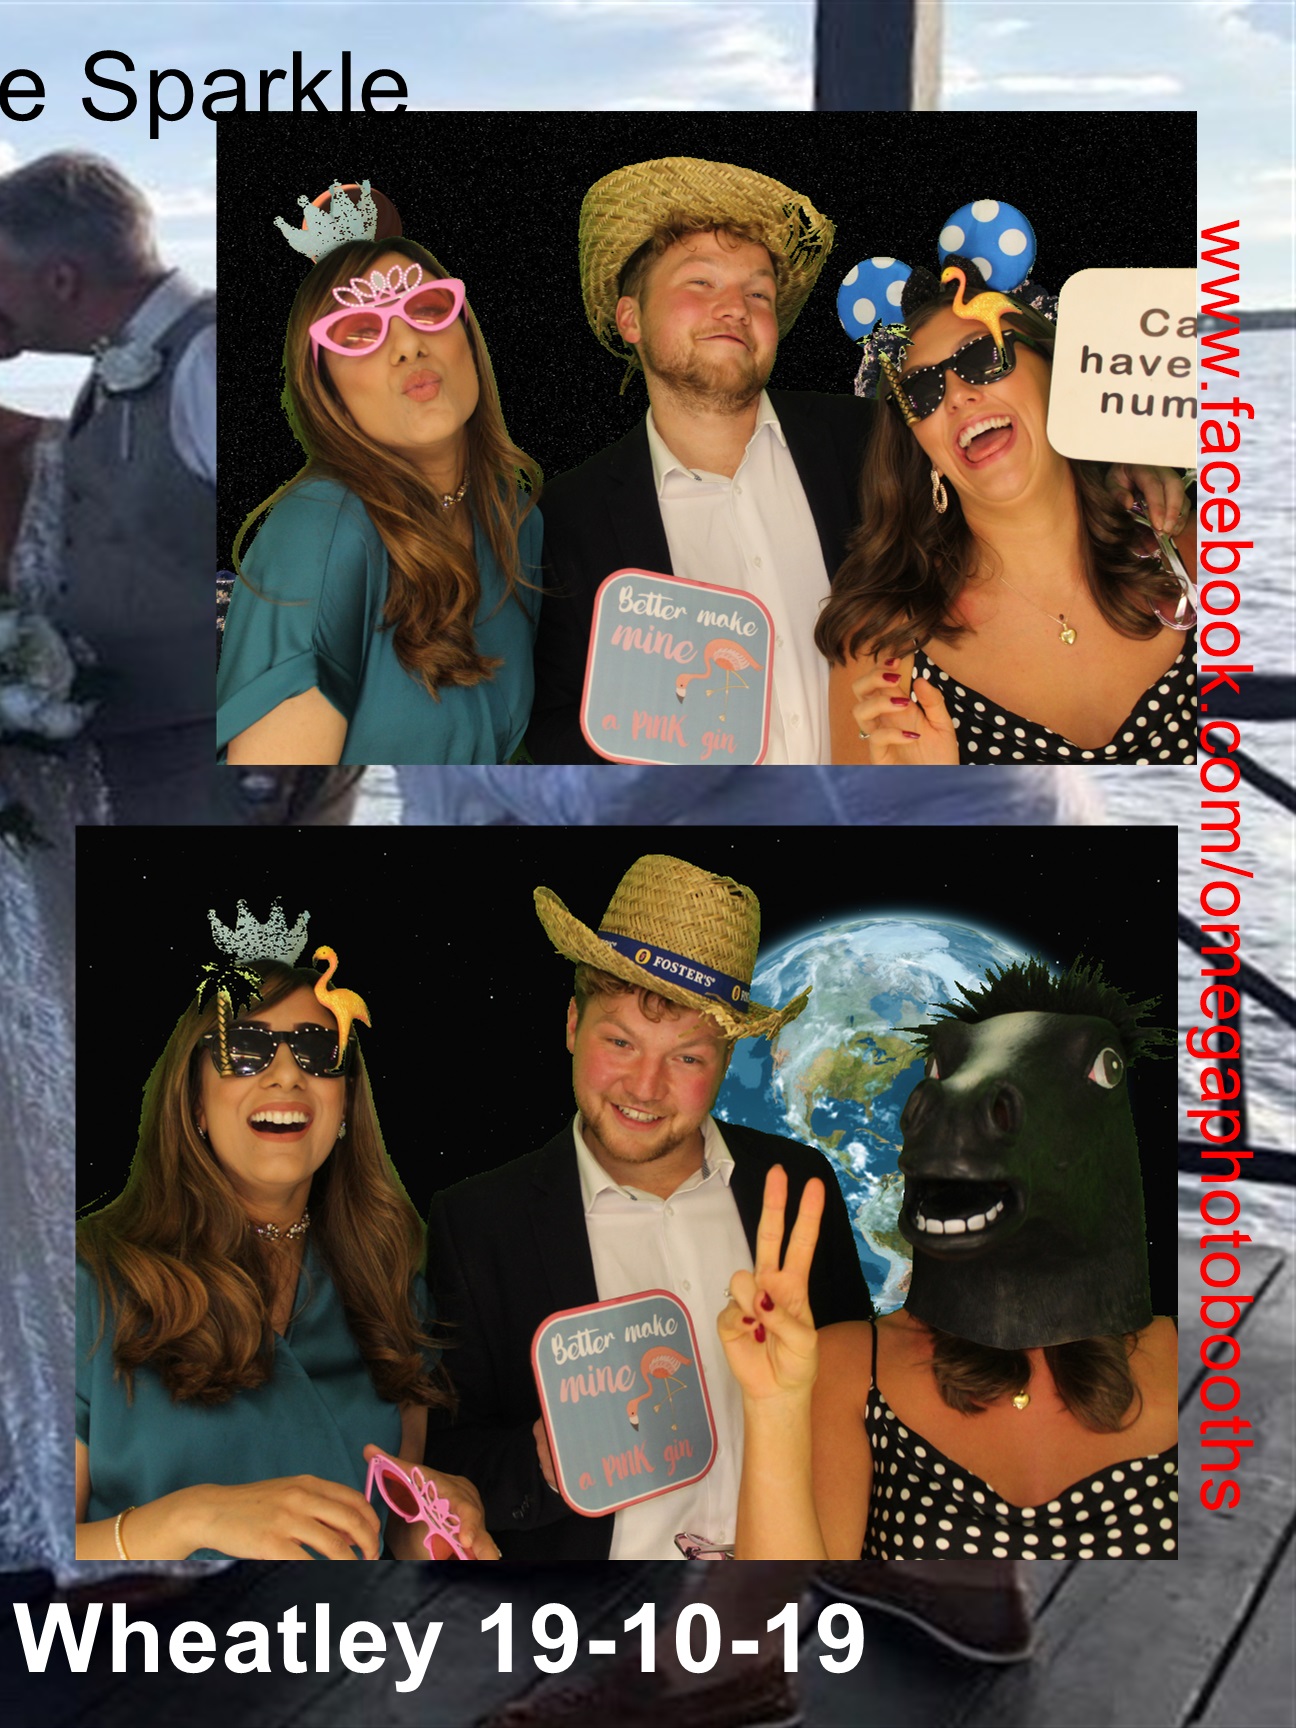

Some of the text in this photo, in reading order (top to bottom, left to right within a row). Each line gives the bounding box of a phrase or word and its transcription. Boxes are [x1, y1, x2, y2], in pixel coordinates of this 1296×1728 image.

[1080, 344, 1192, 379] have
[618, 585, 759, 637] Better make
[610, 624, 698, 664] mine
[602, 713, 620, 730] a
[700, 728, 737, 761] gin
[653, 955, 716, 988] FOSTER'S
[551, 1313, 679, 1366] Better make
[559, 1364, 637, 1404] mine
[578, 1471, 596, 1491] a
[663, 1438, 694, 1476] gin
